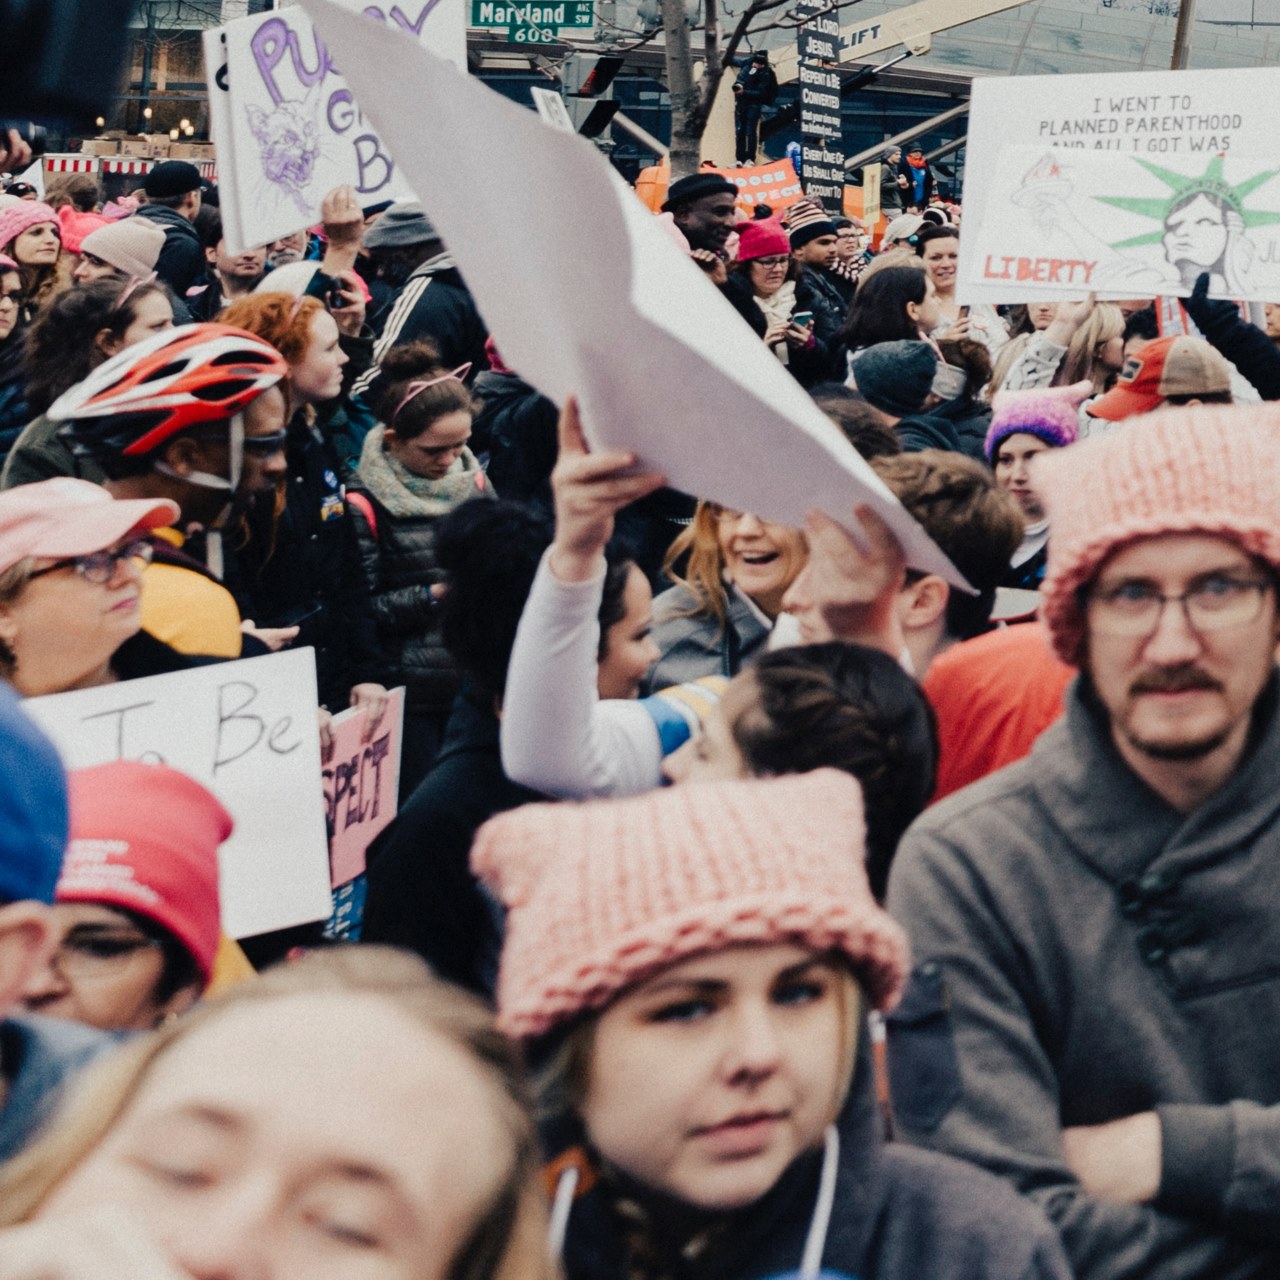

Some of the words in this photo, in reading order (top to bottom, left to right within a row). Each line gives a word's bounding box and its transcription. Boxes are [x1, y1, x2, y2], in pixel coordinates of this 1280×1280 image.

[480, 1, 566, 25] Maryland
[575, 15, 591, 25] SW
[514, 27, 553, 42] 600
[817, 16, 839, 36] LORD
[805, 36, 836, 58] JESUS.
[800, 66, 826, 85] REPENT
[802, 87, 841, 109] CONVERTED
[1093, 97, 1101, 114] I
[1109, 95, 1161, 113] WENT
[1169, 95, 1192, 111] TO
[1039, 118, 1119, 136] PLANNED
[1125, 114, 1242, 134] PARENTHOOD
[1133, 138, 1140, 152] I
[1147, 137, 1182, 153] GOT
[1189, 135, 1231, 152] WAS
[803, 147, 823, 162] EVERY
[823, 149, 836, 164] ONE
[813, 165, 831, 180] SHALL
[806, 182, 834, 197] ACCOUNT
[983, 254, 1098, 284] LIBERTY
[213, 680, 302, 775] Be
[321, 730, 392, 840] SPECT
